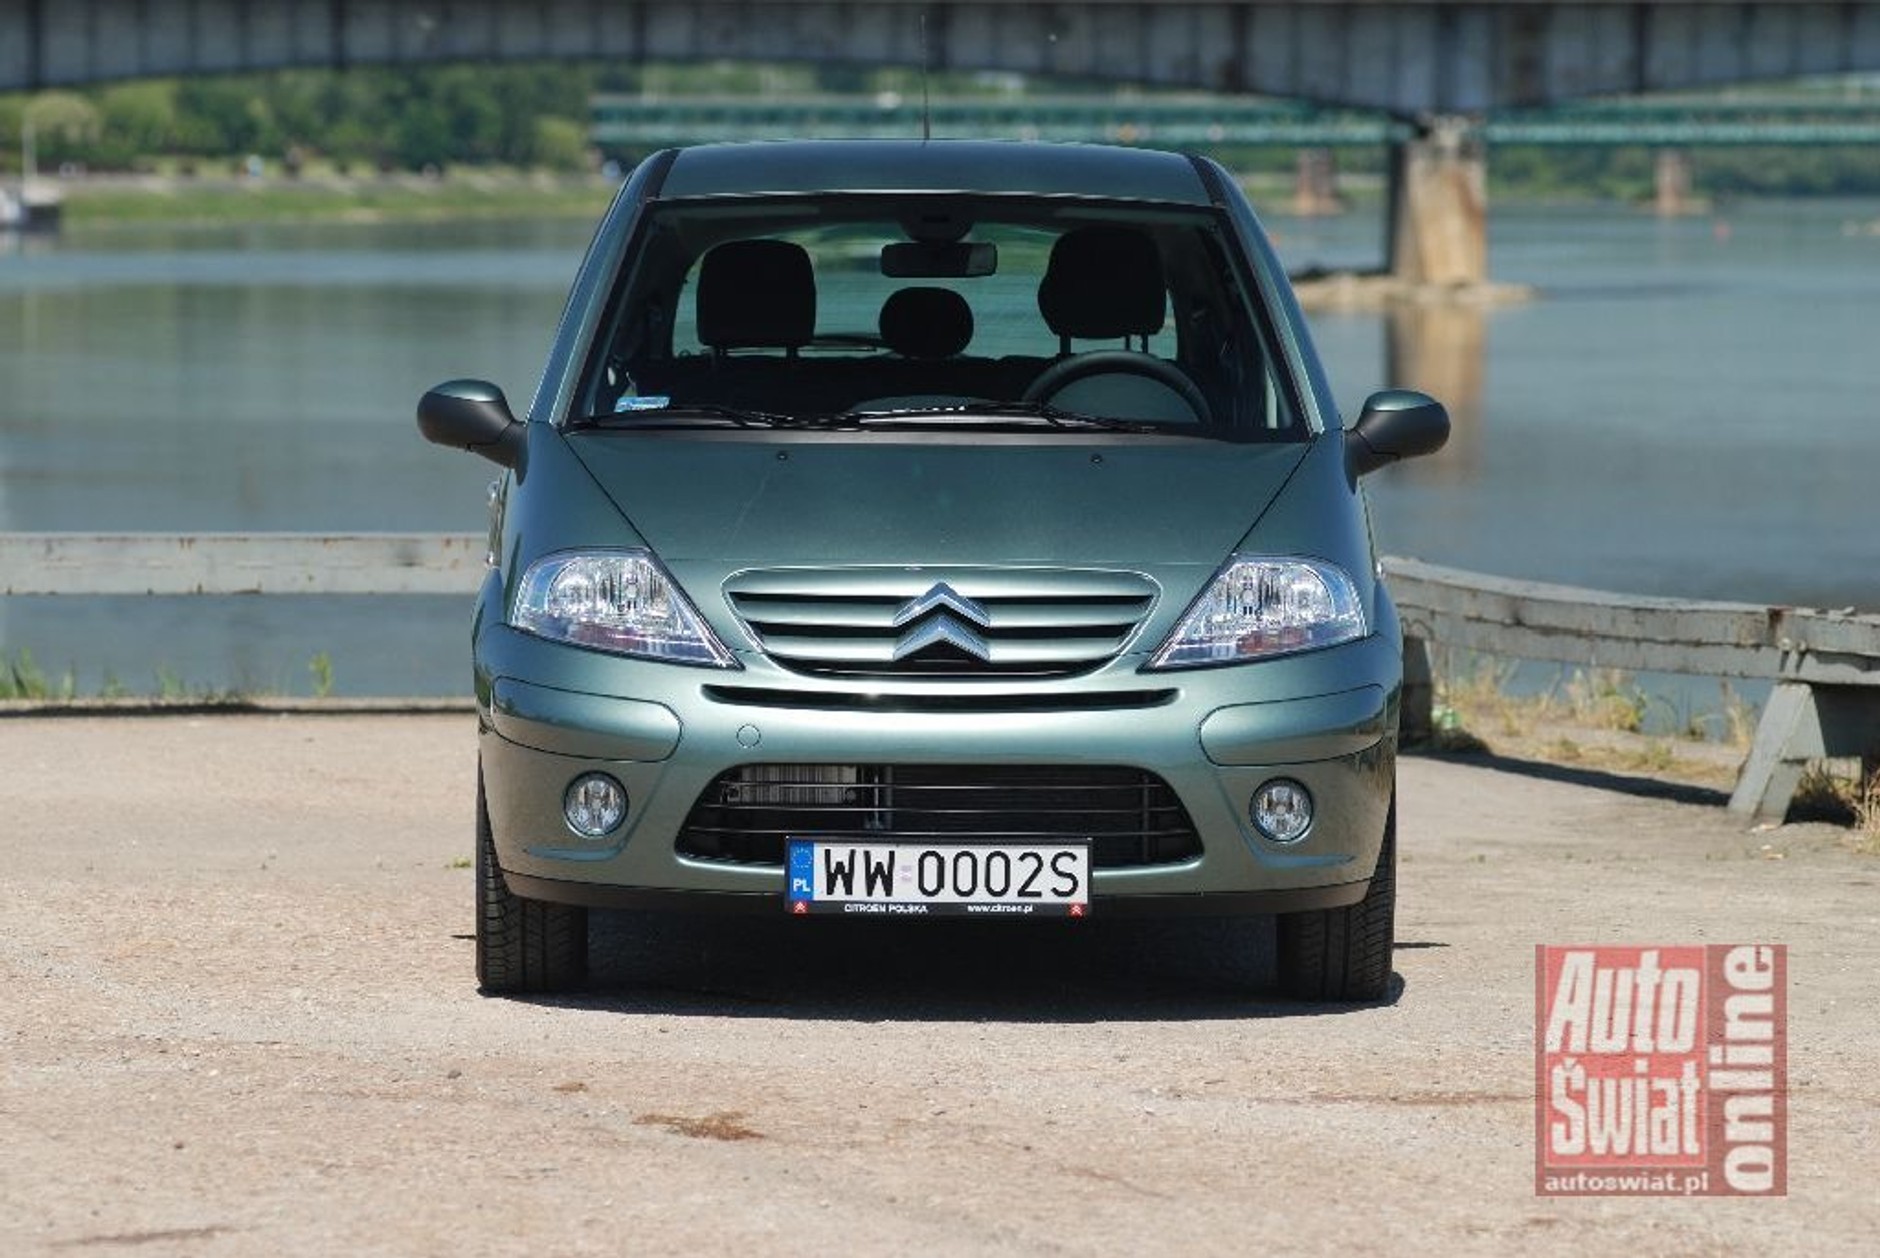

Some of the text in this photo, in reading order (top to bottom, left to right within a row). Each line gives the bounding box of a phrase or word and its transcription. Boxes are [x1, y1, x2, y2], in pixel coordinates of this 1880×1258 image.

[823, 848, 1080, 898] WW 0002S
[792, 879, 812, 893] PL
[888, 903, 929, 914] POLSKA
[967, 903, 1034, 915] www.citroen.pl
